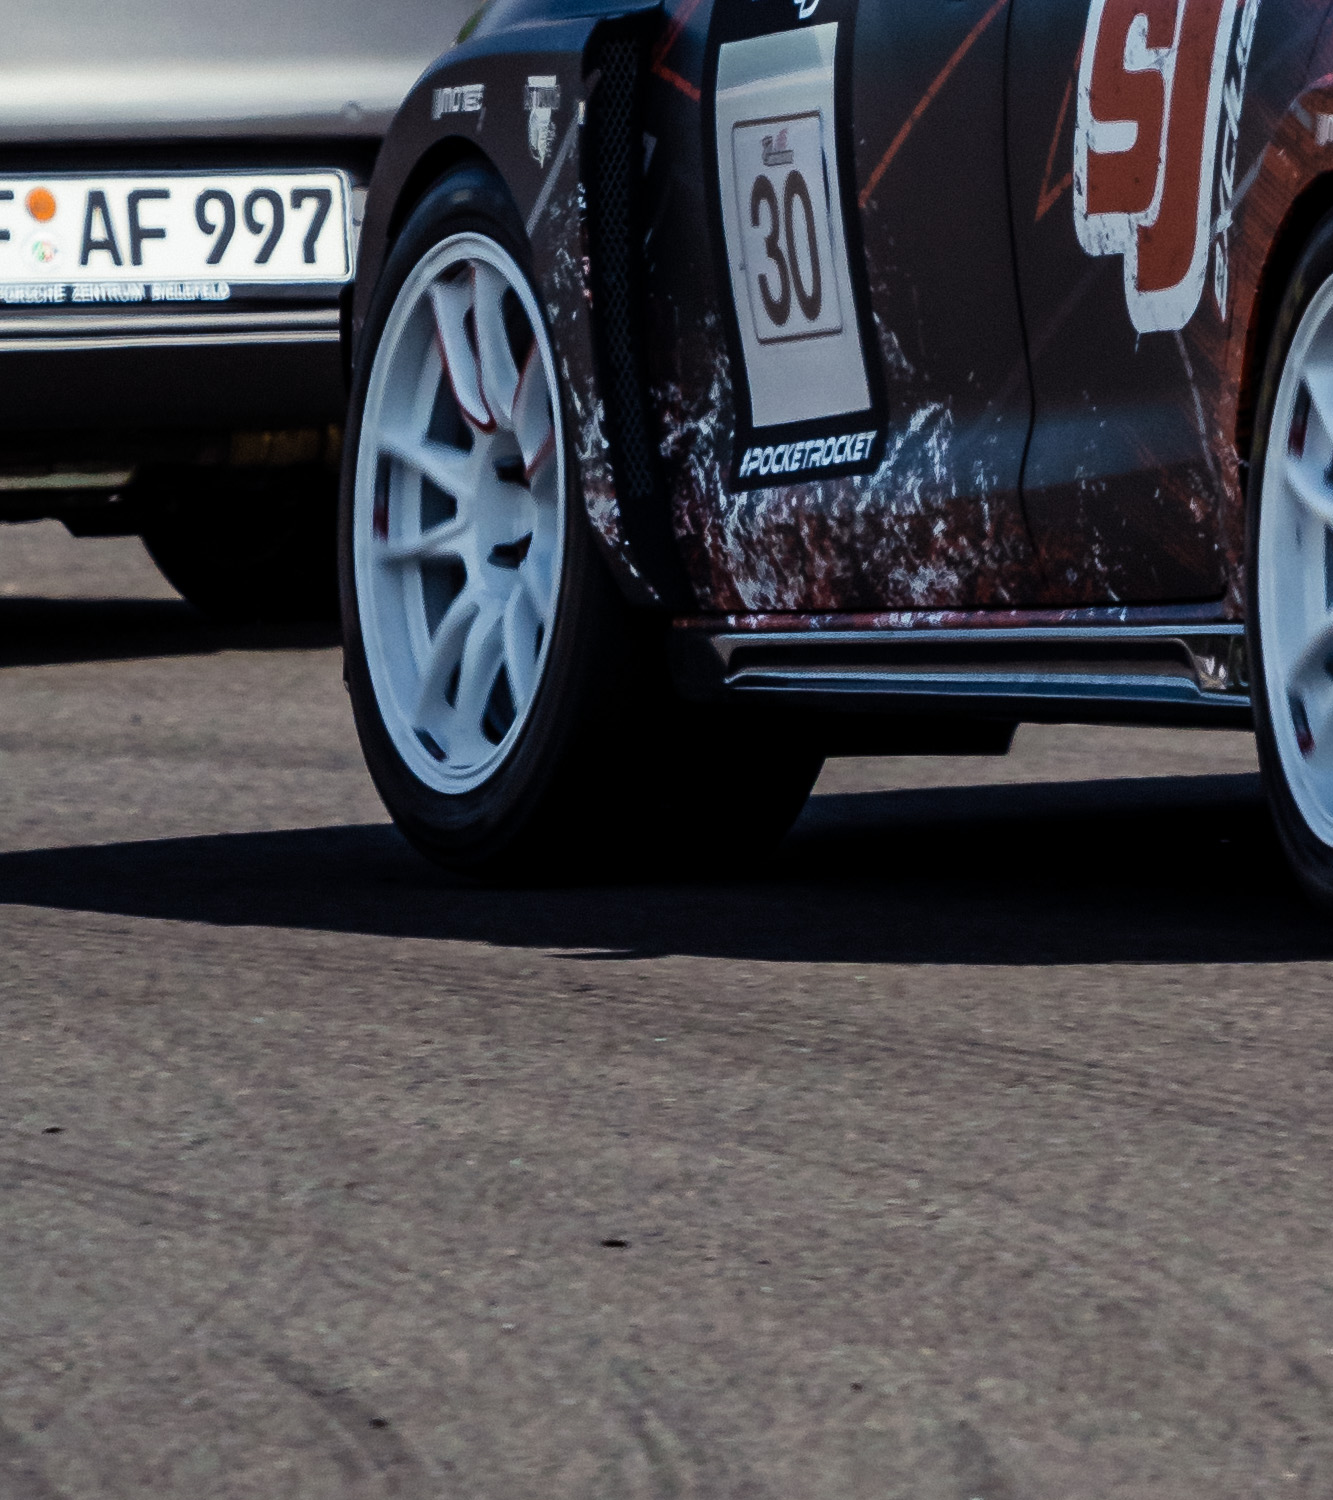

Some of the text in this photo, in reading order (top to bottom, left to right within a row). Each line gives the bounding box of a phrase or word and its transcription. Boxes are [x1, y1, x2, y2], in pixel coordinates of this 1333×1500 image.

[78, 188, 171, 267] AF
[194, 187, 333, 266] 997
[750, 169, 822, 327] 30
